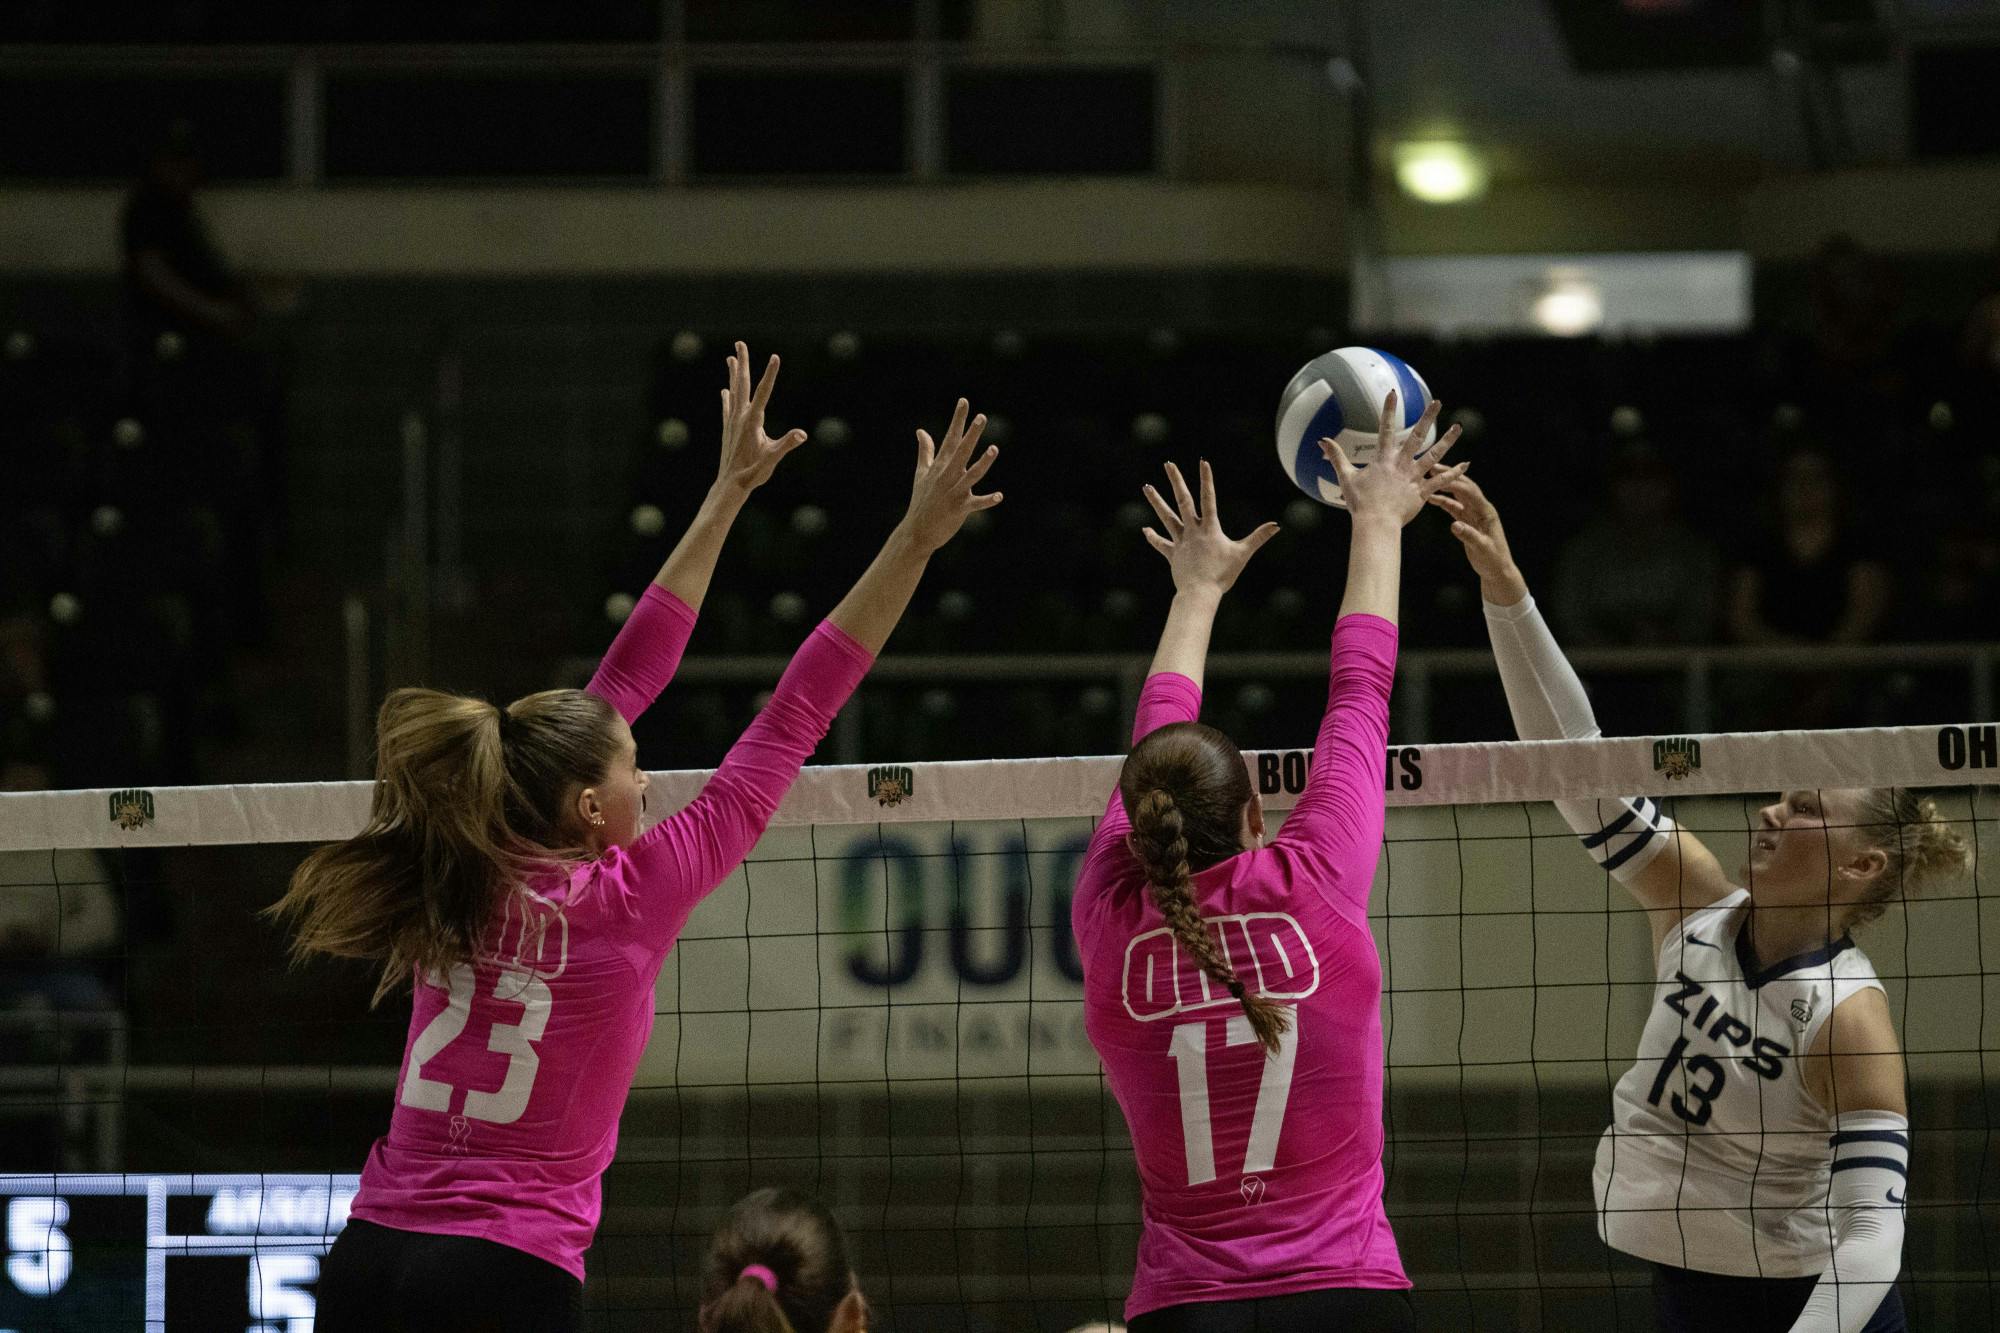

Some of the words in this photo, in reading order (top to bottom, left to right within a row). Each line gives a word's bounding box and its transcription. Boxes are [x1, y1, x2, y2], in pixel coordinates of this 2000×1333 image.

[400, 960, 554, 1125] 23
[1647, 1034, 1727, 1127] 13
[1663, 970, 1791, 1081] ZIPS
[1166, 1002, 1299, 1187] 17
[5, 1196, 73, 1297] 5
